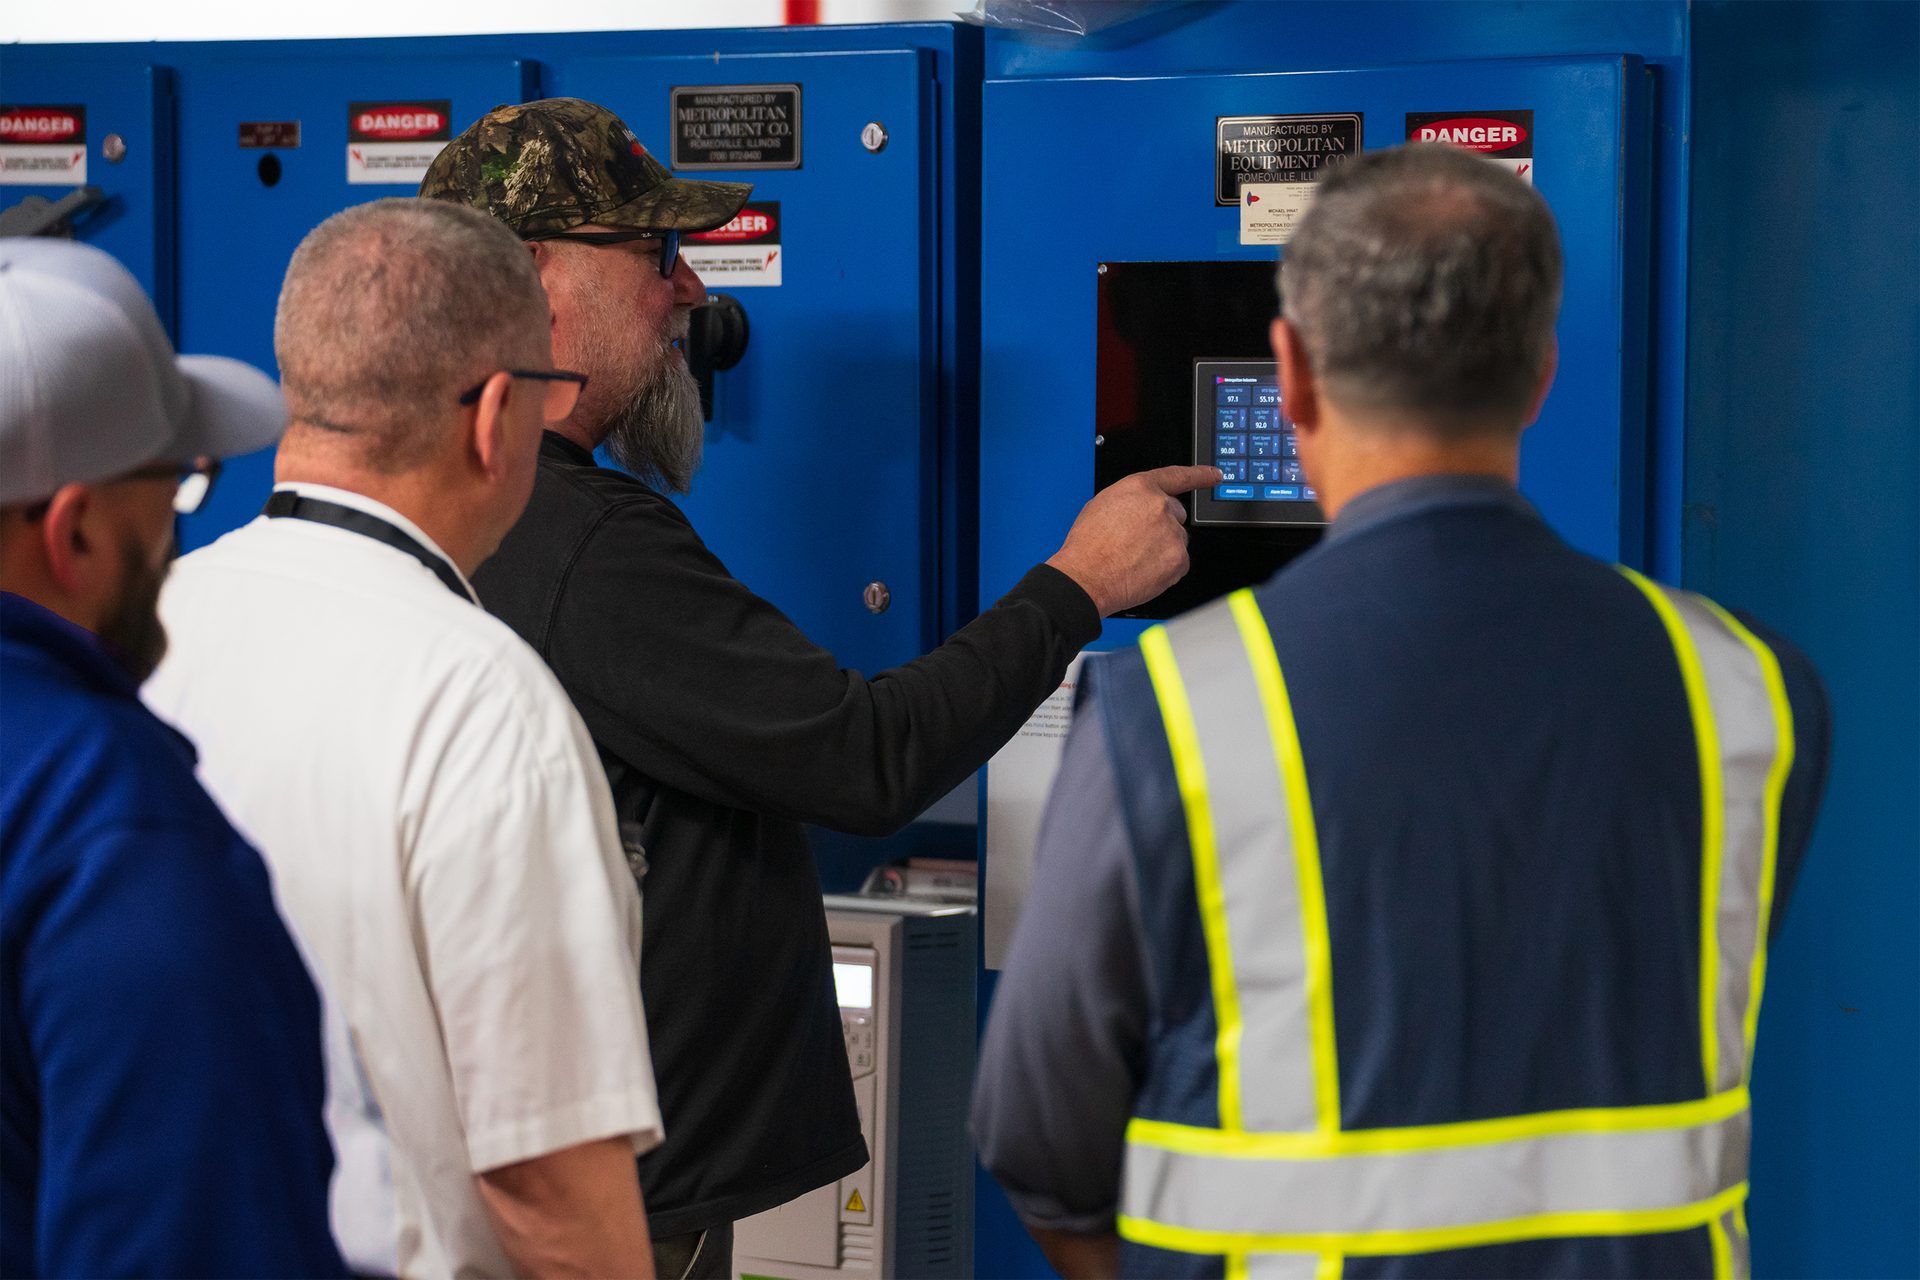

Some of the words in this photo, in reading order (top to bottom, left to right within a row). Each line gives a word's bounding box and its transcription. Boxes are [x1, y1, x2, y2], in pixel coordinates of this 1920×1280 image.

[694, 94, 761, 105] MANUFACTURED
[765, 94, 777, 103] BY
[679, 106, 787, 121] METROPOLITAN
[0, 117, 75, 134] DANGER
[361, 113, 440, 132] DANGER
[683, 122, 764, 138] EQUIPMENT
[768, 122, 792, 136] CO.
[1243, 125, 1318, 136] MANUFACTURED
[1321, 124, 1334, 134] BY
[1421, 127, 1517, 143] DANGER
[746, 139, 781, 148] ILLINOIS
[1224, 137, 1345, 154] METROPOLITAN
[1231, 154, 1320, 171] EQUIPMENT
[721, 215, 768, 232] GER
[1259, 395, 1274, 403] 55.19
